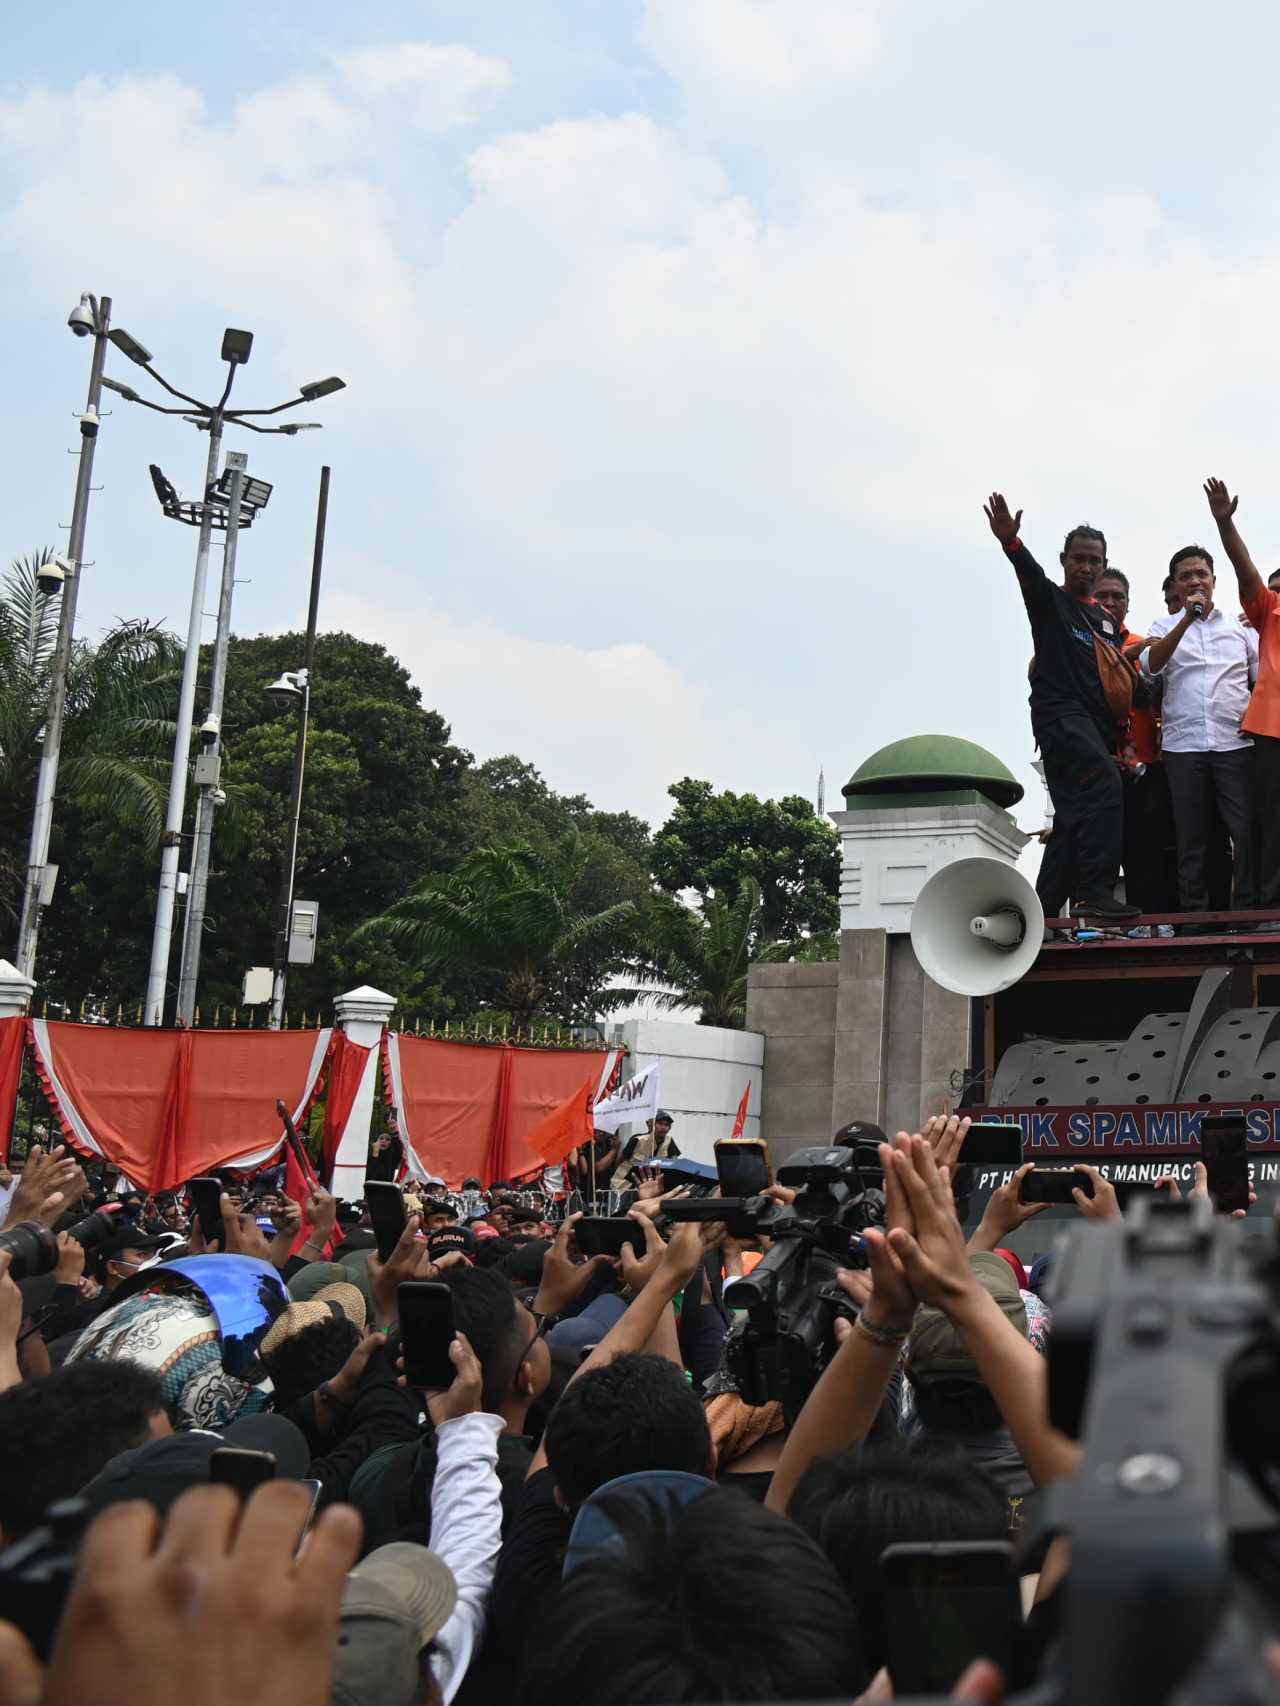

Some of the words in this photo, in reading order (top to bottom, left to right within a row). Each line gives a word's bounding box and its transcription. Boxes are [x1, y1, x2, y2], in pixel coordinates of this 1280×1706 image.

[1067, 1110, 1208, 1147] SPAMK
[978, 1172, 999, 1190] PT
[432, 1234, 465, 1245] BURUH
